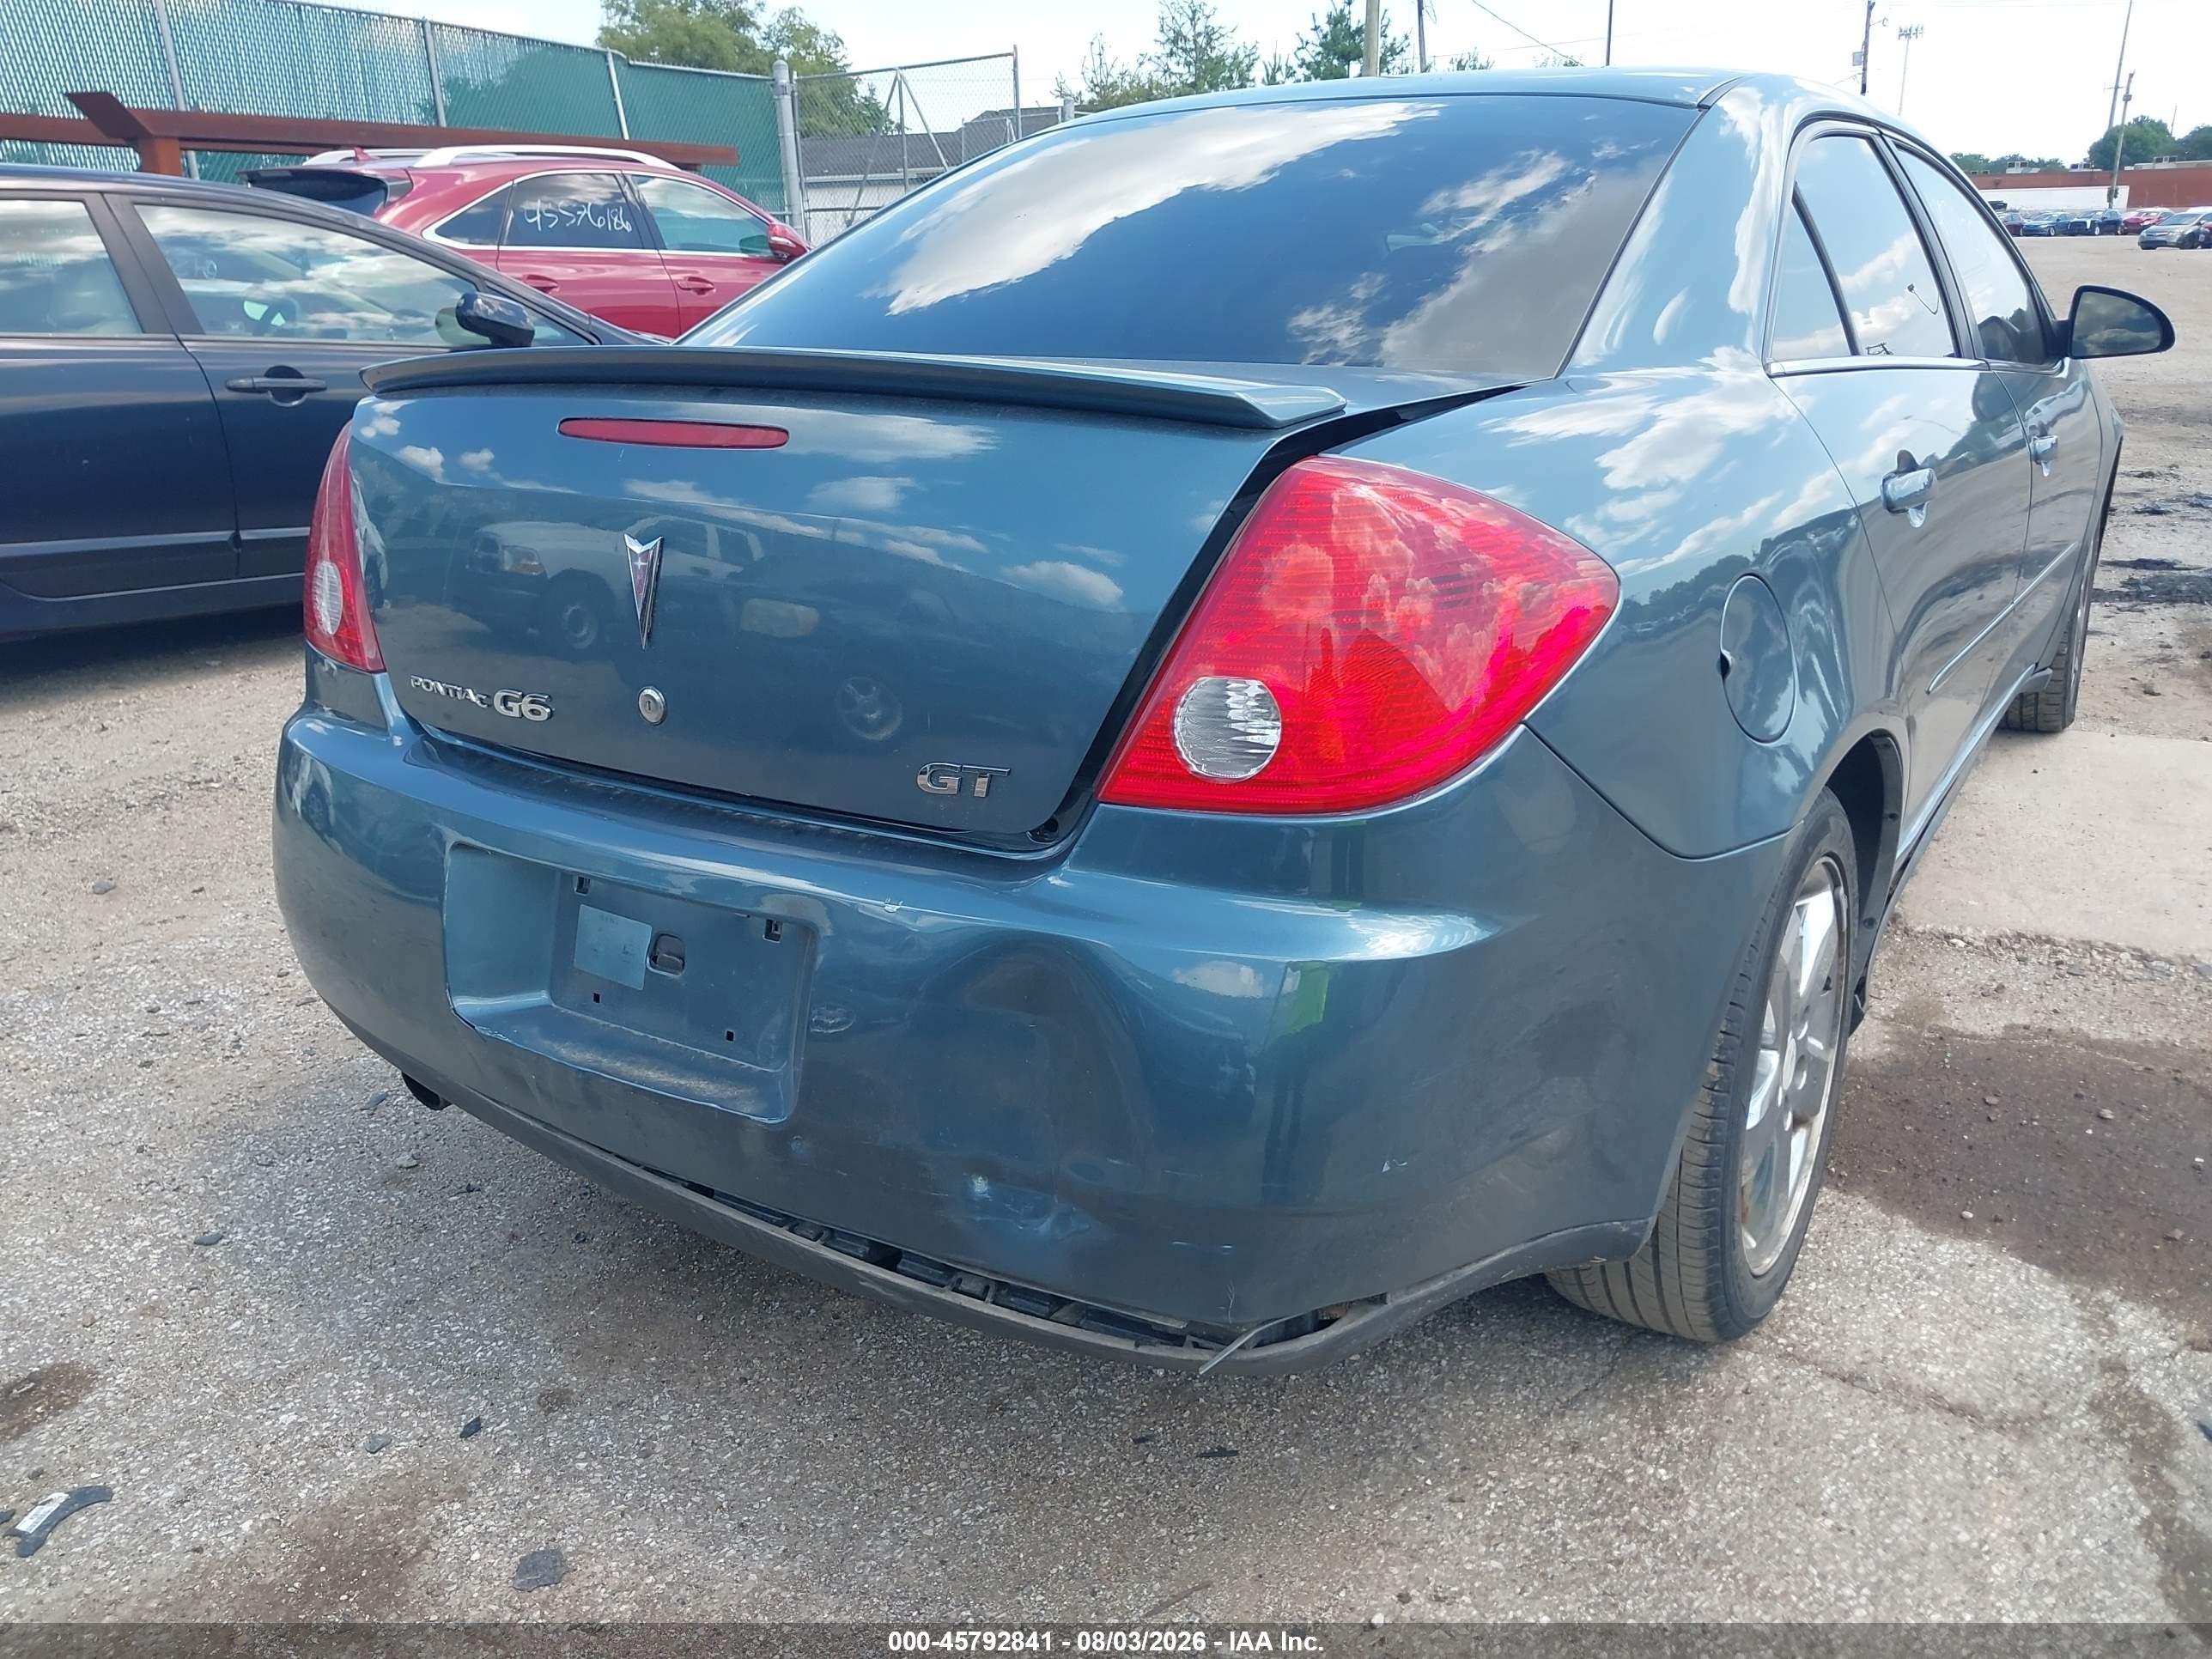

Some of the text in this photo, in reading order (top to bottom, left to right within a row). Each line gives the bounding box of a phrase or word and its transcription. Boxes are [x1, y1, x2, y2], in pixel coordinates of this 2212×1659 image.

[410, 675, 552, 722] PONTIAC G6
[916, 762, 1011, 798] GT
